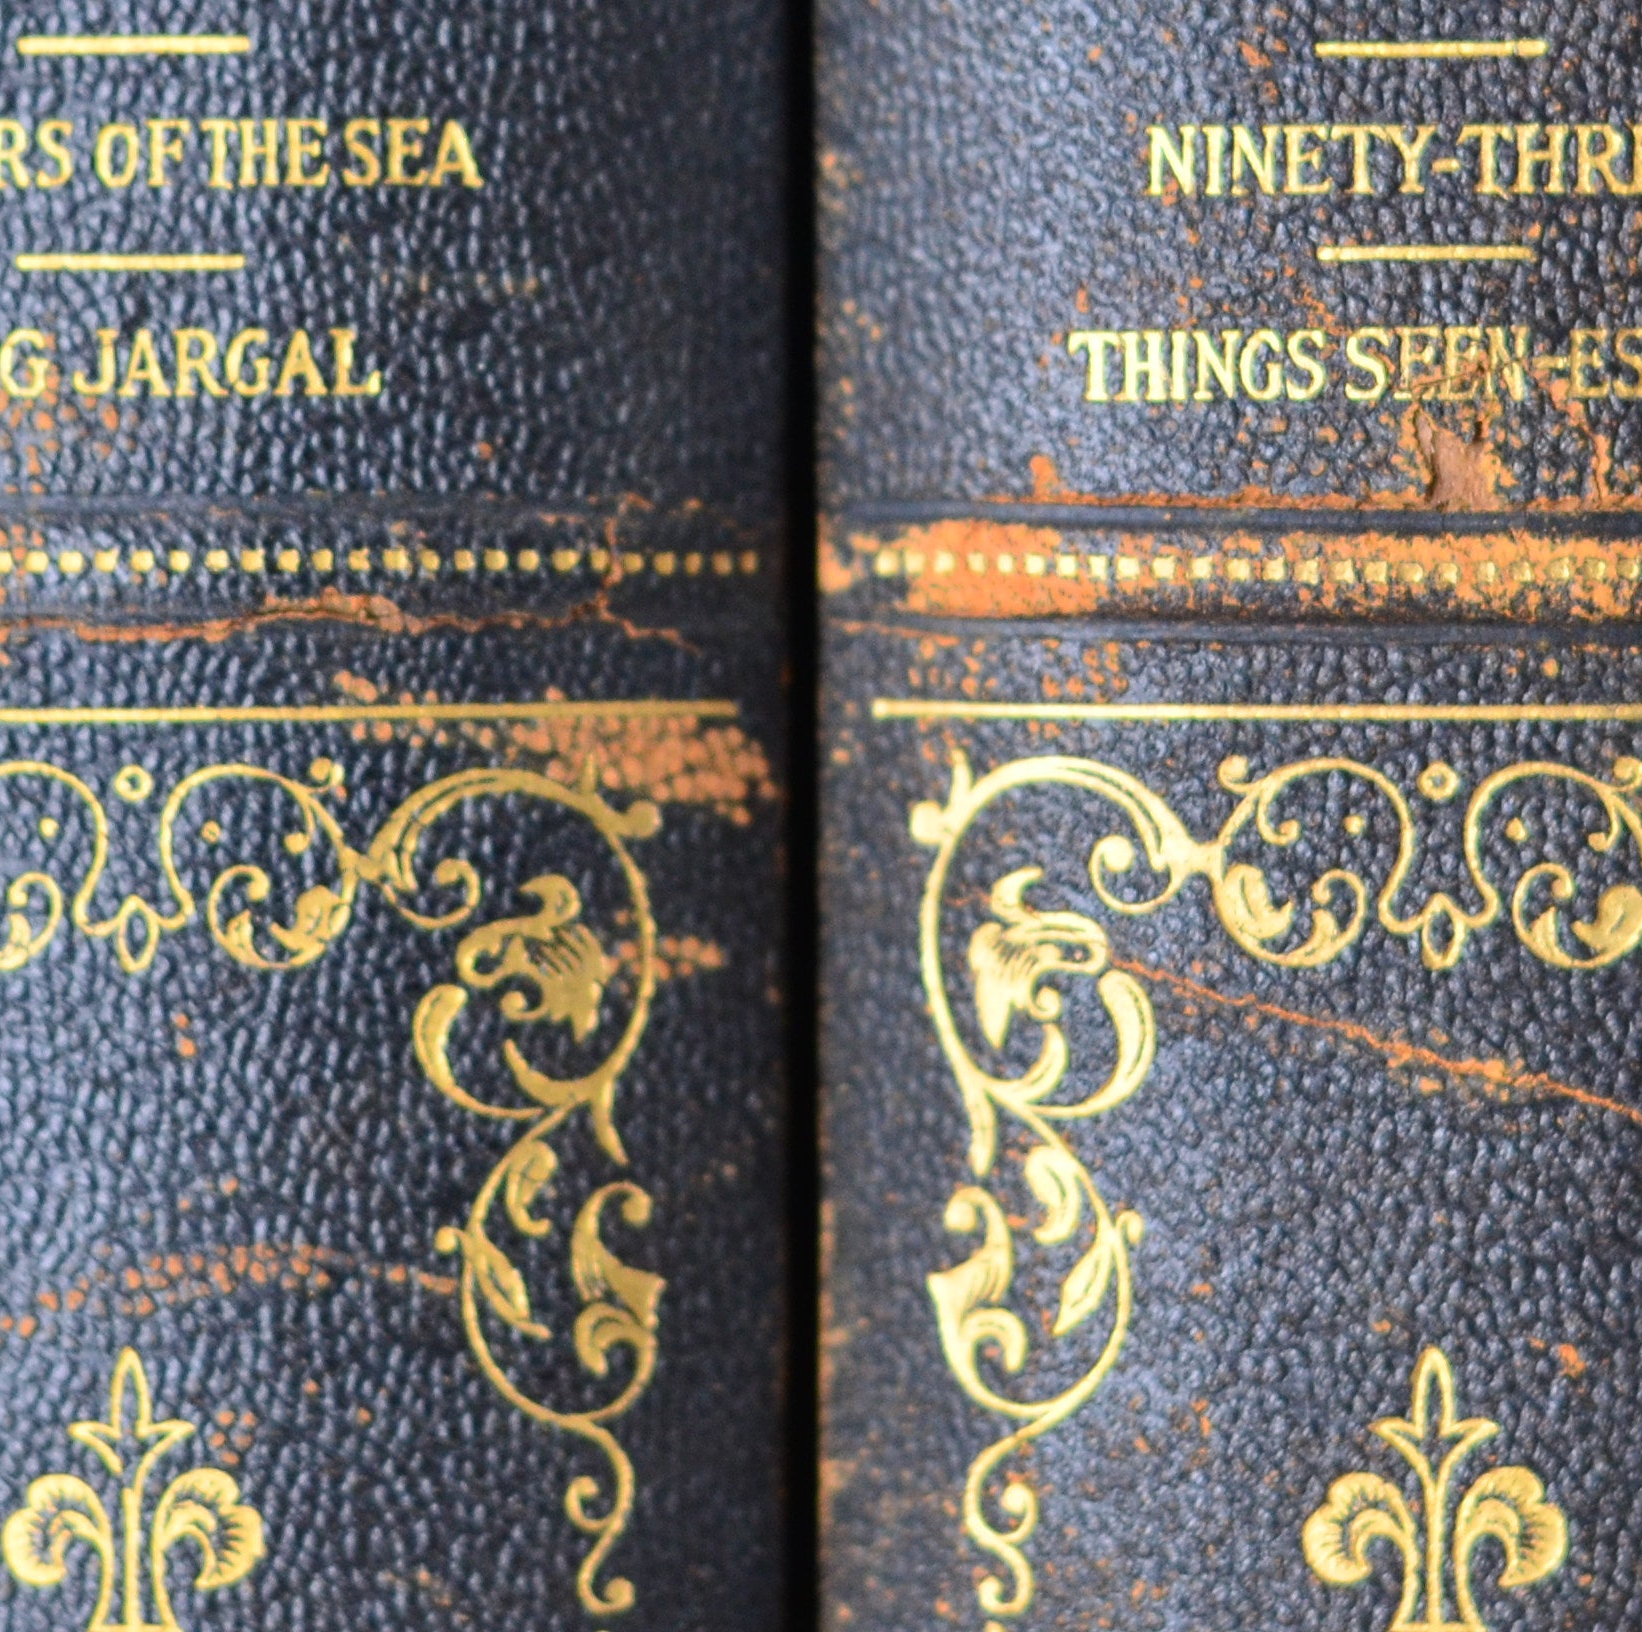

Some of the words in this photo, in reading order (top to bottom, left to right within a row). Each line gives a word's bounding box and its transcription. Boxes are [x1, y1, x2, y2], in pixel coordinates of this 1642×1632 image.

[96, 120, 188, 188] OF
[204, 120, 328, 188] THE
[346, 120, 483, 188] SEA
[71, 328, 381, 396] JARGAL
[1069, 328, 1326, 402] THINGS
